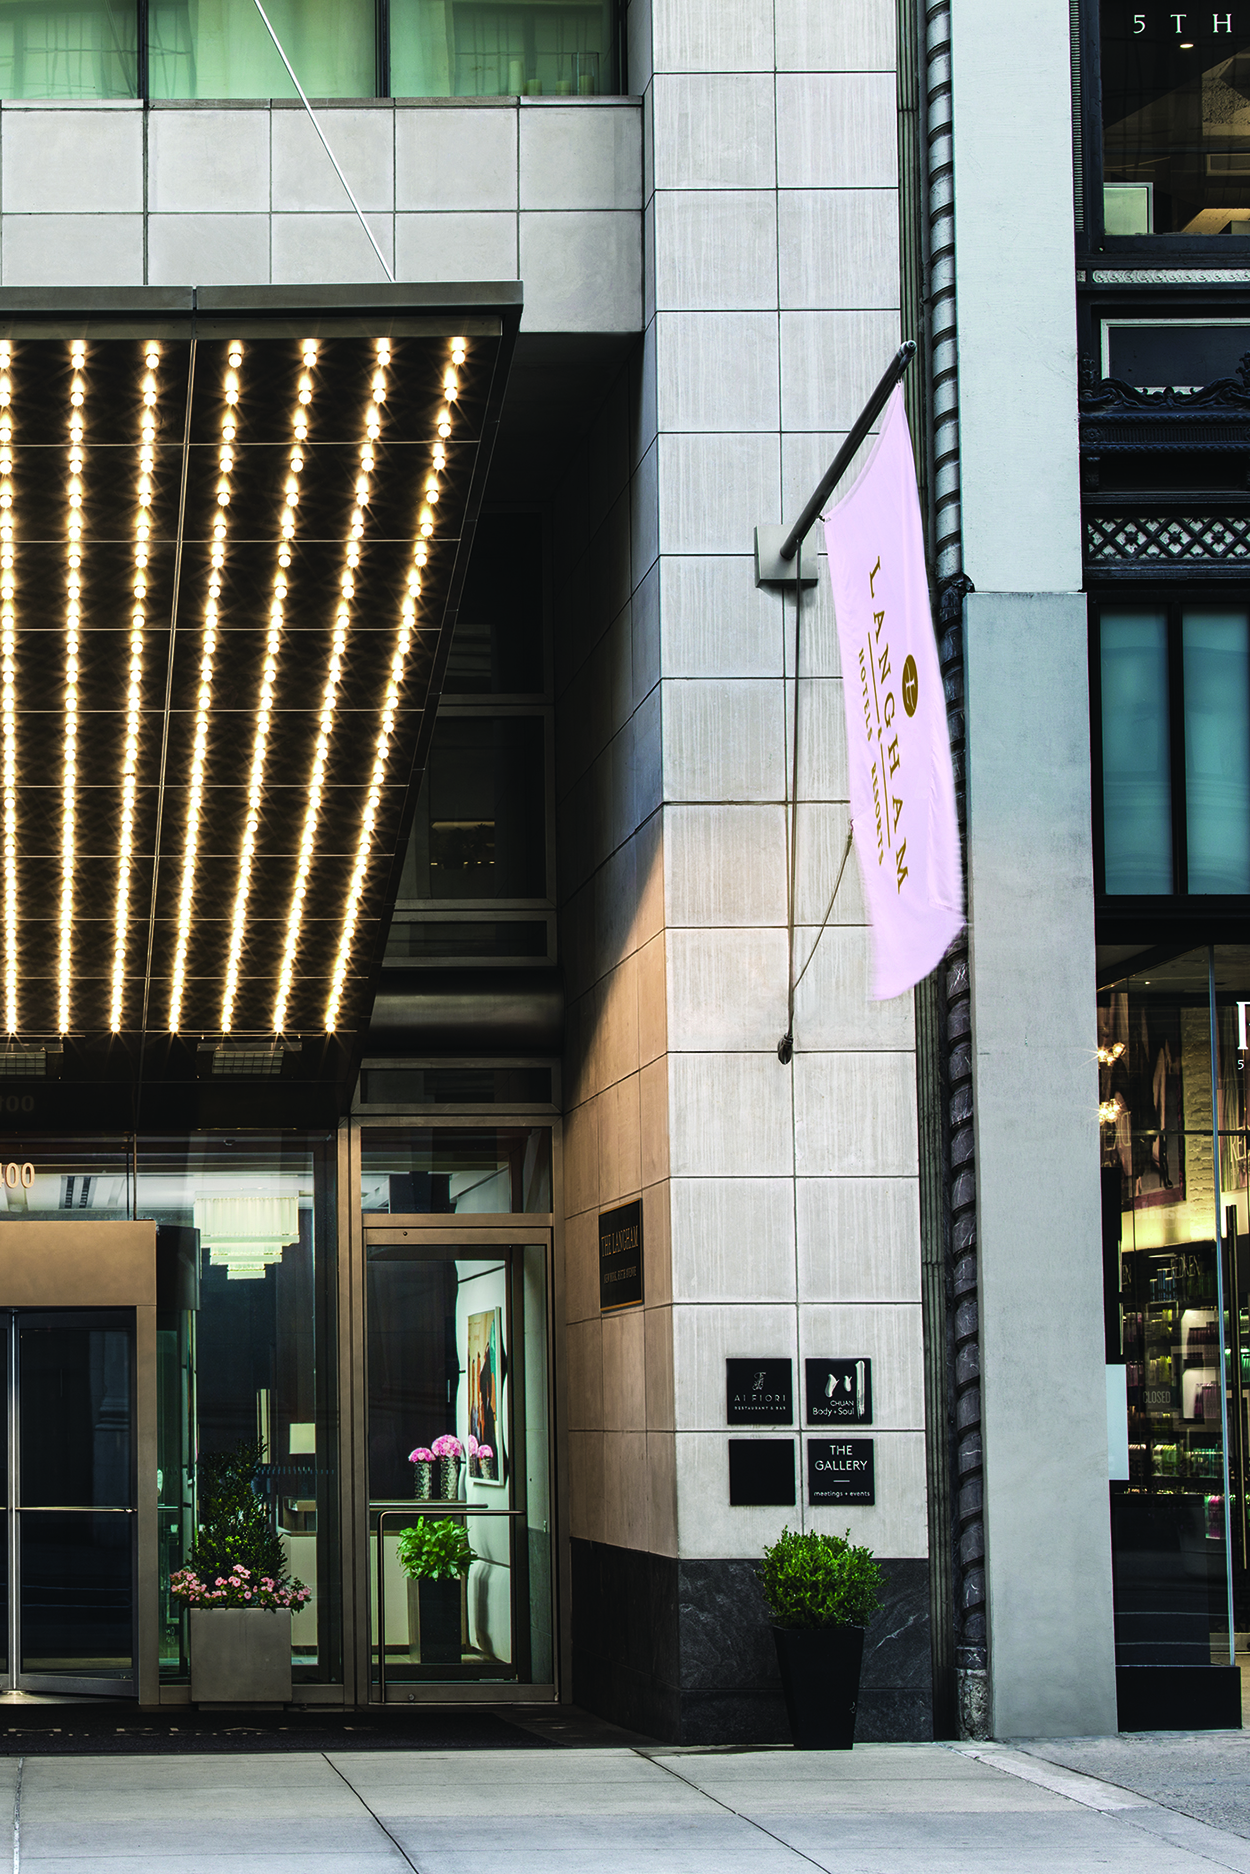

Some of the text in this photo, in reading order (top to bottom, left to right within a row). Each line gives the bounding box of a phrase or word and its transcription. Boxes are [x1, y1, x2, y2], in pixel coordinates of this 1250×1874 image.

[1133, 13, 1232, 34] 5TH
[859, 648, 872, 741] HOTELS
[869, 555, 908, 894] LANGHAM
[1143, 1391, 1171, 1404] CLOSED
[813, 1407, 832, 1417] Body
[838, 1407, 854, 1415] Soul
[830, 1445, 853, 1455] THE
[815, 1460, 868, 1471] GALLERY
